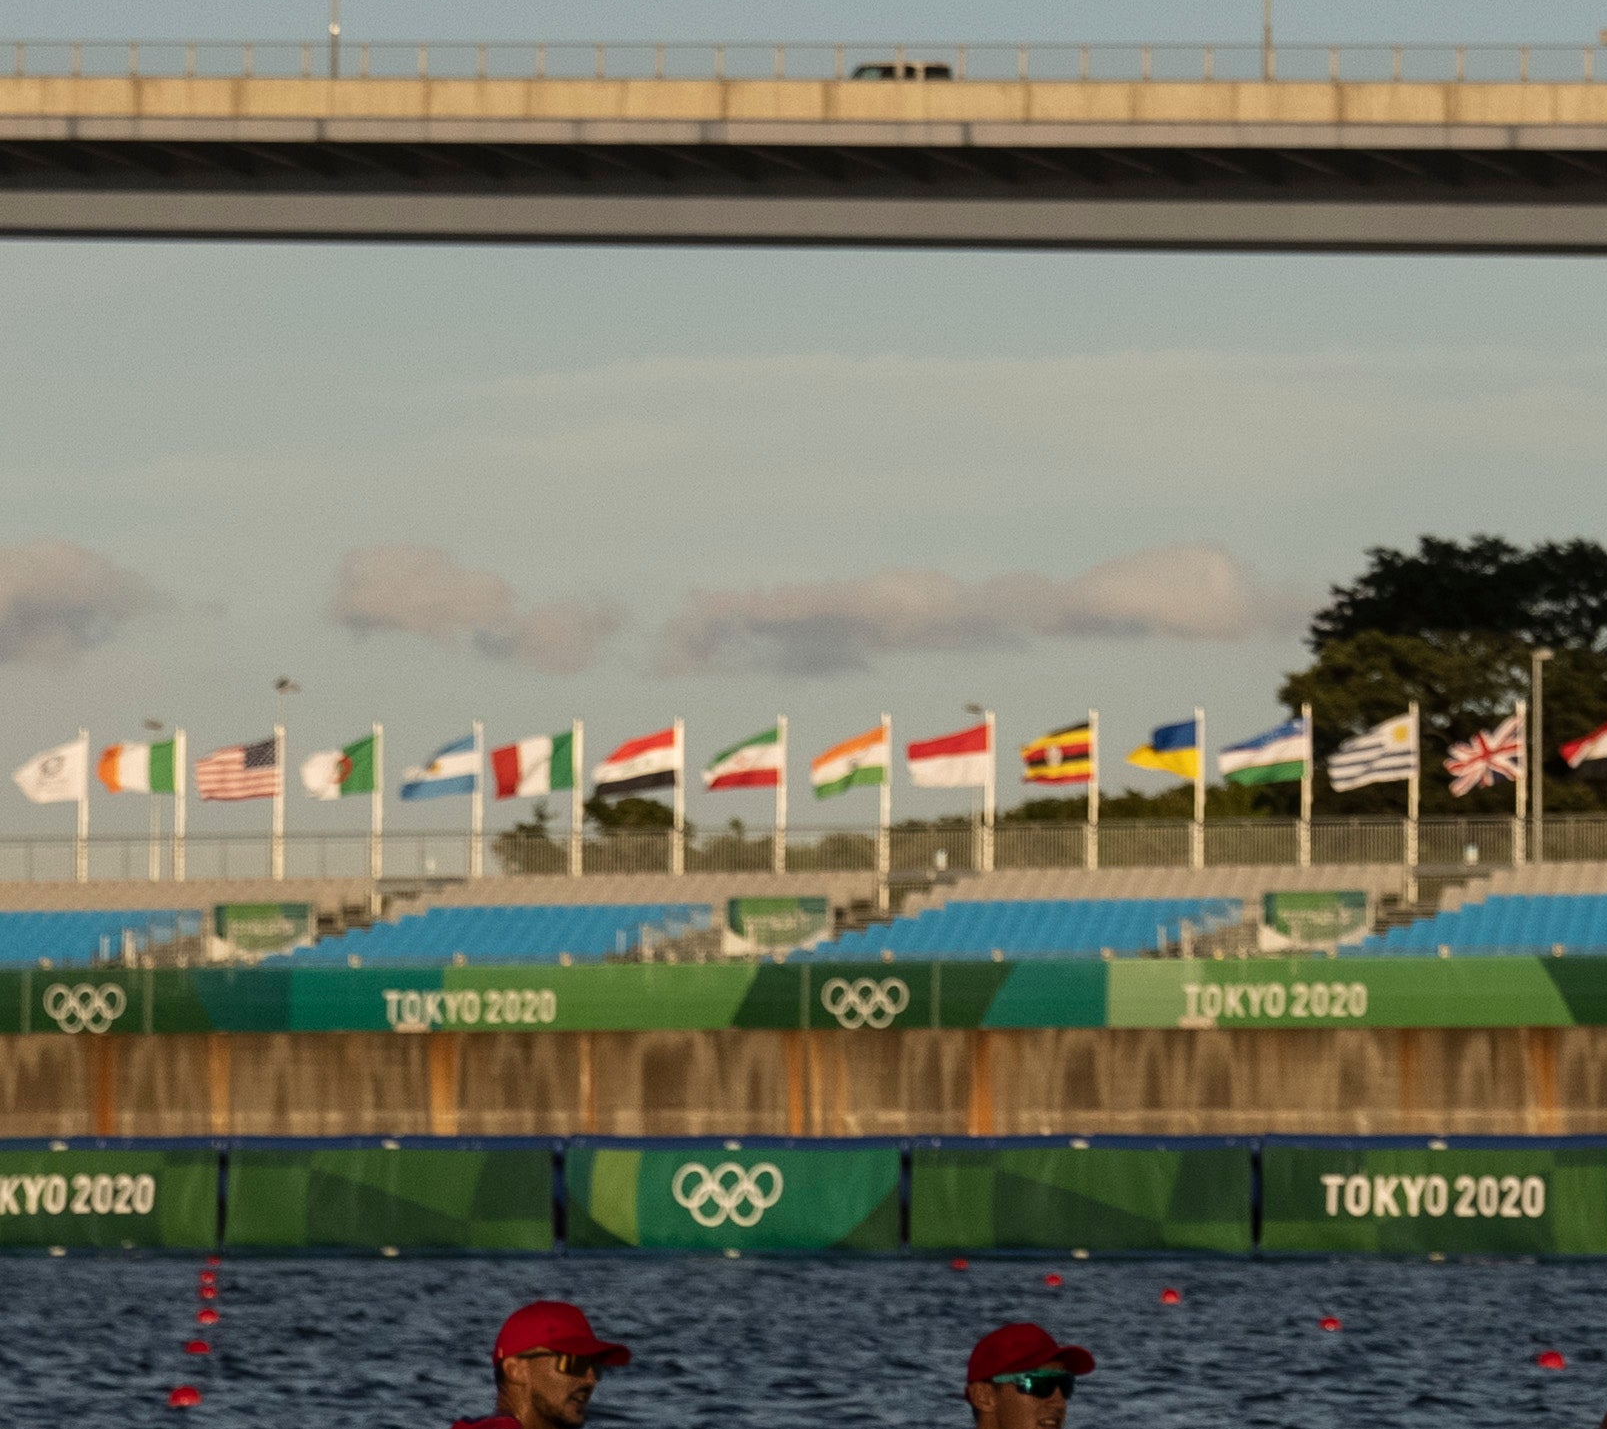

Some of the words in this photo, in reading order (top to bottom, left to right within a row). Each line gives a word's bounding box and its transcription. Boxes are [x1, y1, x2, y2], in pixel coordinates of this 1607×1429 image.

[383, 989, 482, 1024] TOKYO
[485, 989, 557, 1024] 2020
[1181, 982, 1287, 1018] TOKYO
[1290, 982, 1369, 1018] 2020
[71, 1174, 156, 1215] 2020
[1322, 1174, 1449, 1217] TOKYO
[1454, 1175, 1545, 1218] 2020
